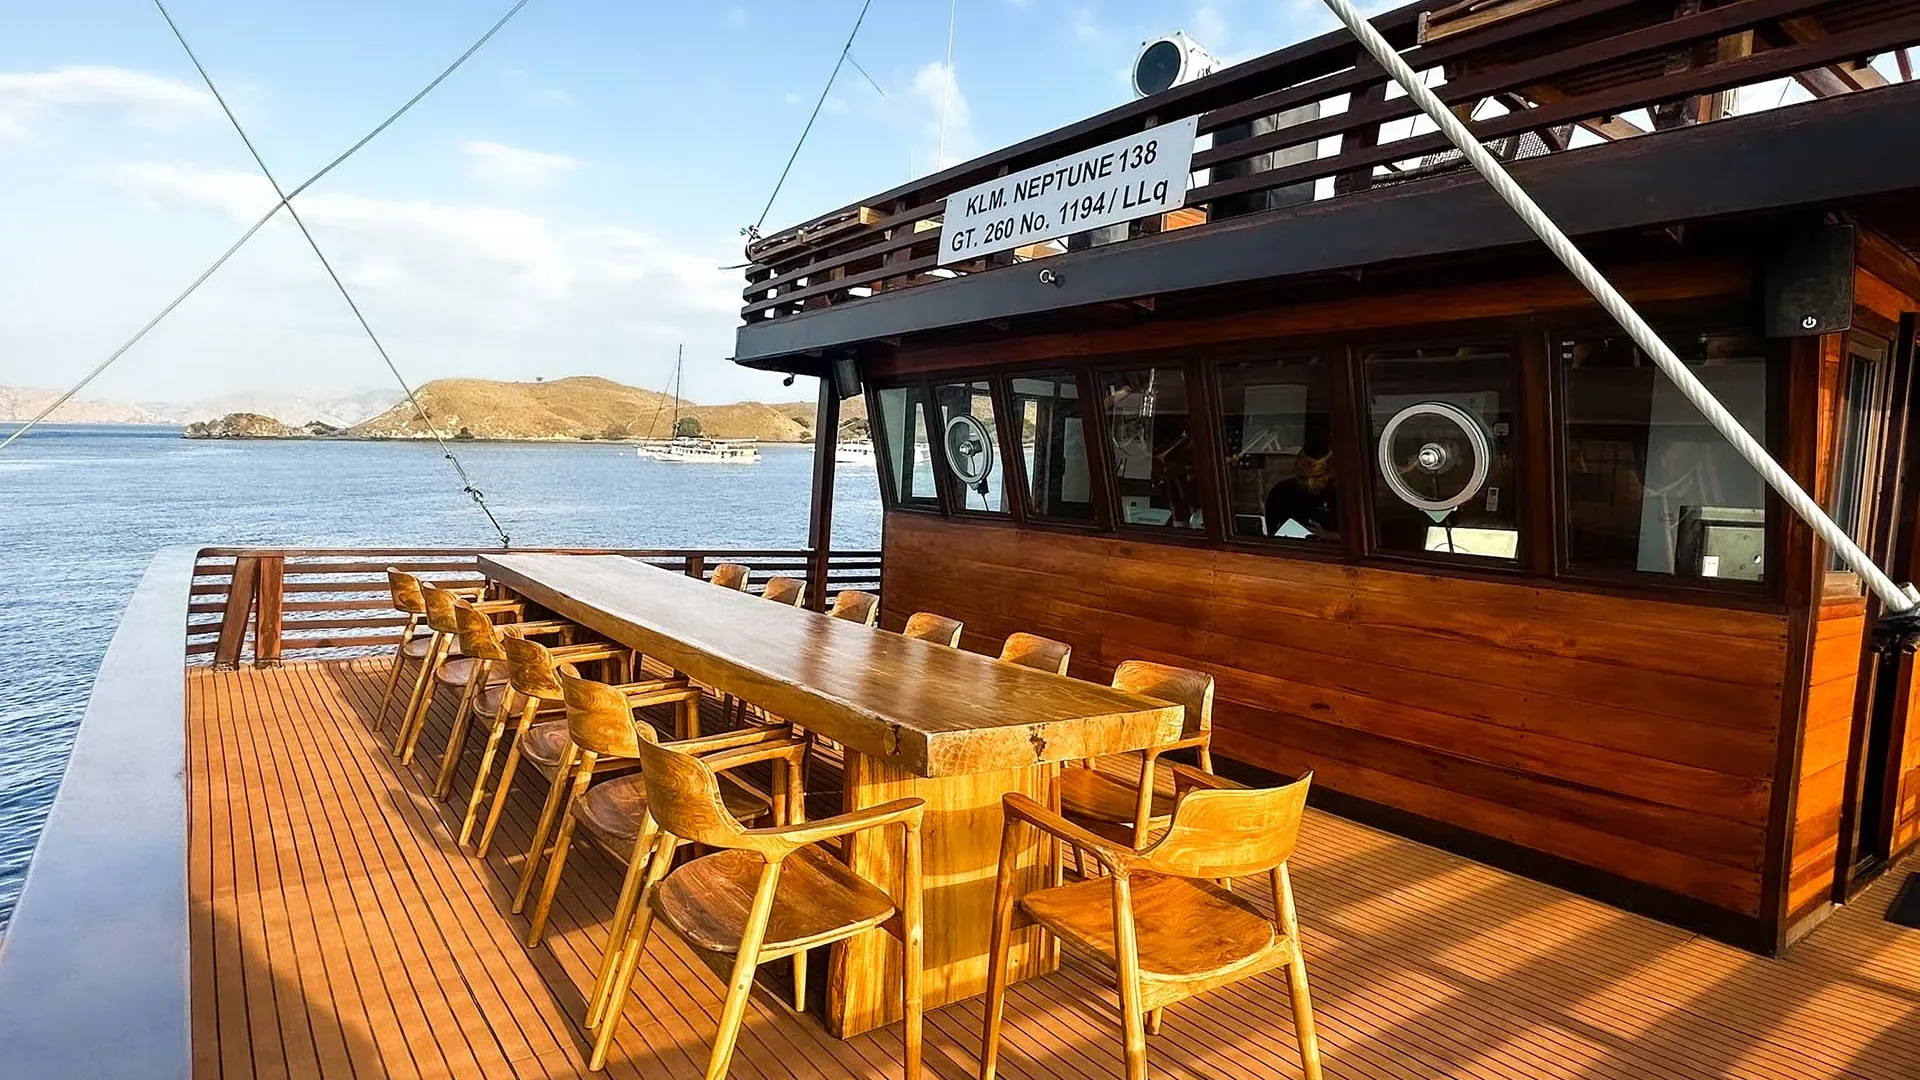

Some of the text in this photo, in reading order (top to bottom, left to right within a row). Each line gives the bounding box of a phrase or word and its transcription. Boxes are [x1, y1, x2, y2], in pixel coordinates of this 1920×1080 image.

[965, 139, 1158, 218] KLM. NEPTUNE 138
[951, 227, 978, 252] GT.
[983, 214, 1015, 245] 260
[1019, 211, 1050, 235] No.
